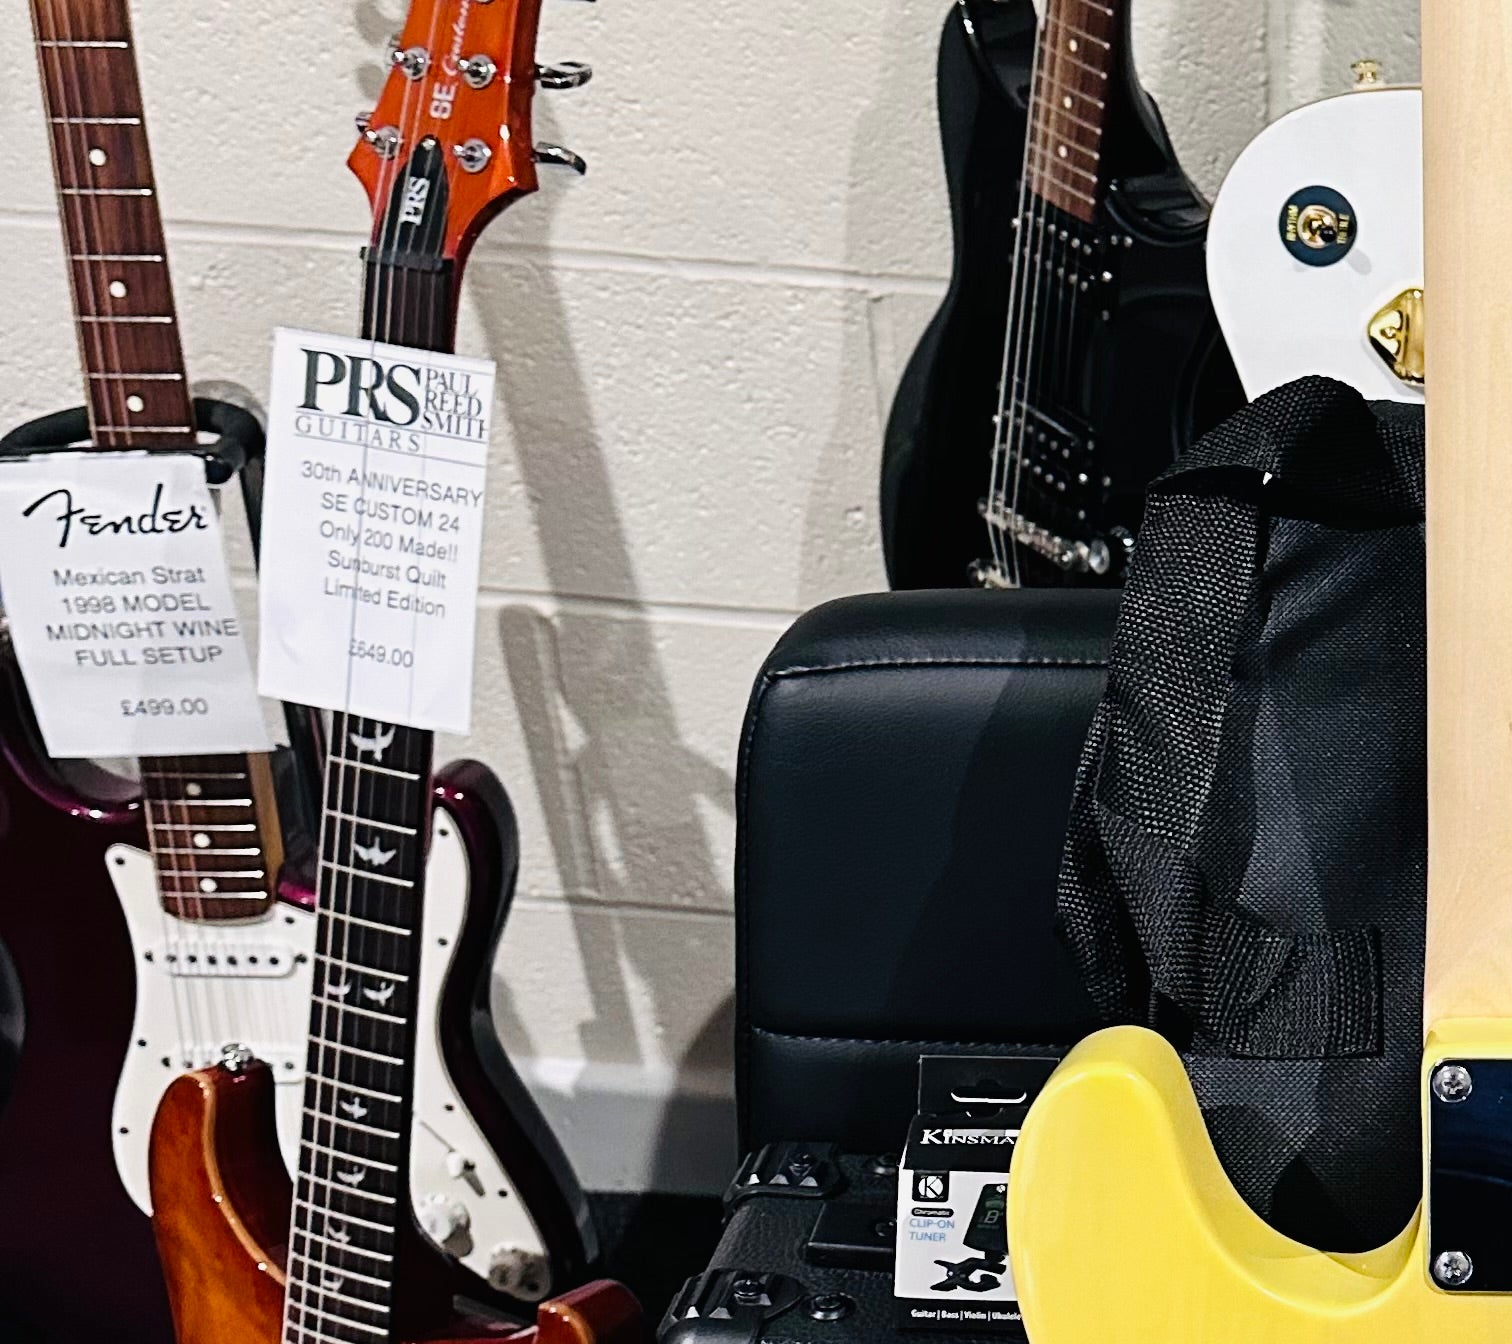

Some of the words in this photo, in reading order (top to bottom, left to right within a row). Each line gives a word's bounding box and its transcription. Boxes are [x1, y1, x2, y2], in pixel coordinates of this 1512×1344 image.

[296, 347, 423, 427] PRS
[425, 367, 480, 396] PAUL
[425, 390, 482, 419] REED
[294, 414, 421, 454] GUITARS
[301, 460, 341, 485] 30th
[347, 467, 484, 508] ANNIVERSARY
[22, 483, 208, 548] Fender
[320, 491, 349, 513] SE
[353, 497, 433, 529] CUSTOM
[438, 513, 461, 534] 24
[319, 520, 361, 546] Only
[363, 528, 394, 551] 200
[53, 567, 145, 587] Mexican
[151, 565, 207, 585] Strat
[328, 549, 401, 583] Sunburst
[406, 565, 447, 590] Quilt
[62, 595, 117, 614] 1998
[123, 592, 212, 613] MODEL
[387, 590, 447, 619] Edition
[45, 620, 168, 642] MIDNIGHT
[172, 617, 240, 638] WINE
[75, 648, 137, 667] FULL
[143, 645, 224, 665] SETUP
[120, 697, 209, 717] £499.00
[909, 1218, 955, 1229] CLIP-ON
[909, 1231, 946, 1242] TUNER
